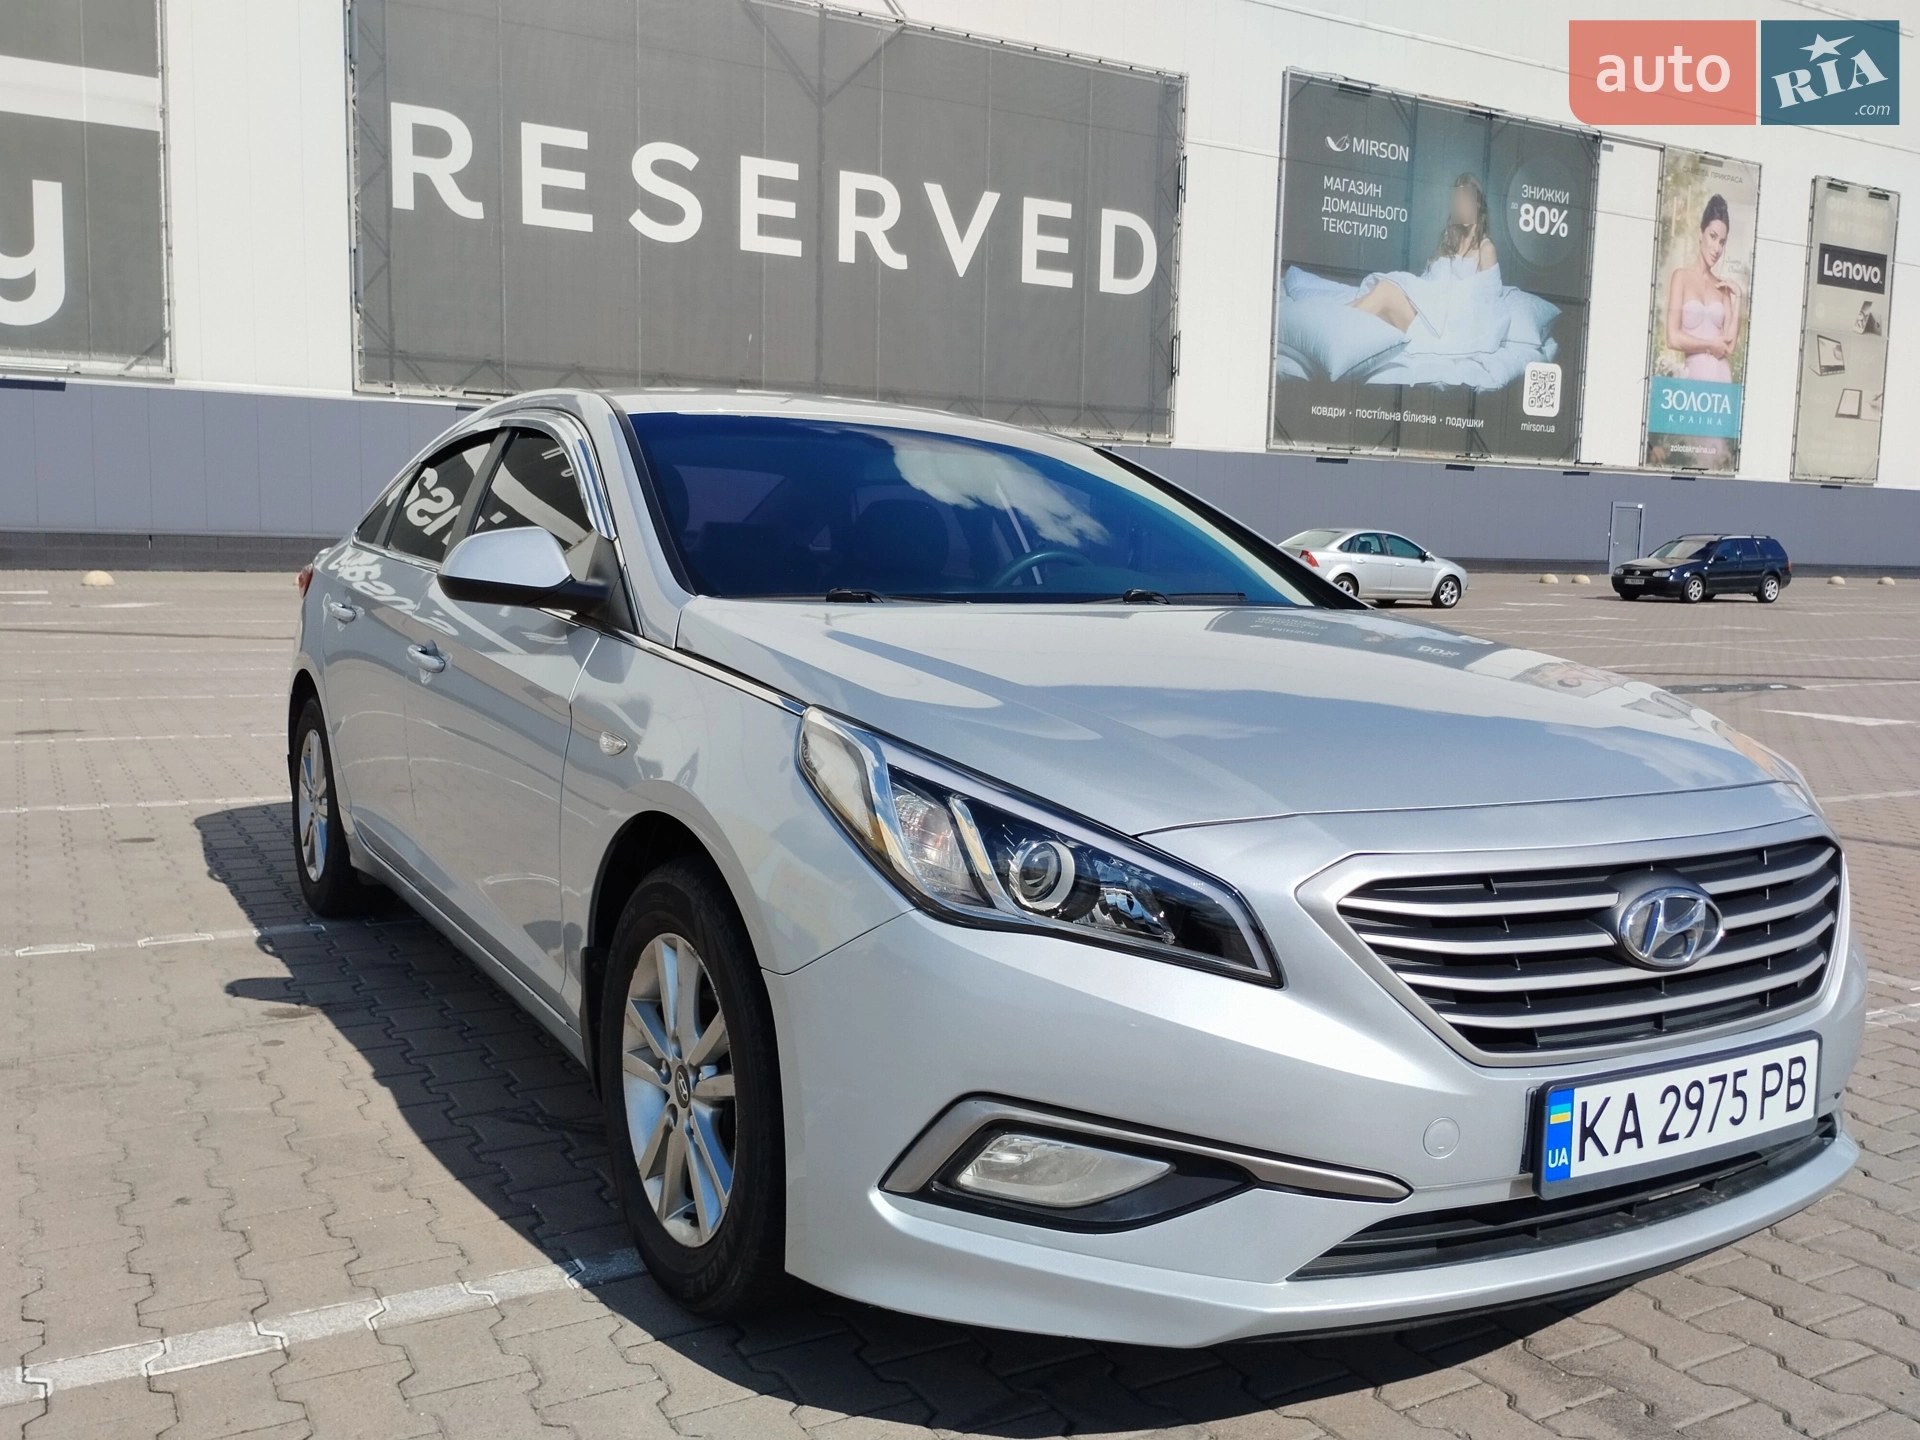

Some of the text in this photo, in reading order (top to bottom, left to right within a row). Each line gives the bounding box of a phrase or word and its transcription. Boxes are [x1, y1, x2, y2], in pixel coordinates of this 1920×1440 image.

[1352, 136, 1409, 162] MIRSON
[390, 102, 1157, 295] RESERVED
[1323, 175, 1382, 198] МАГАЗИН
[1521, 183, 1570, 205] ЗНИЖКИ
[1322, 196, 1408, 223] ДОМАШНЬОГО
[1518, 203, 1569, 238] 80%
[1321, 217, 1388, 240] ТЕКСТИЛЮ
[1823, 253, 1881, 284] Lenovo
[1660, 388, 1732, 415] ЗОЛОТА
[1311, 405, 1484, 429] ковдри постільна білизна подушки
[1520, 421, 1556, 433] mirson.ua
[1578, 1055, 1808, 1162] KA 2975 PB
[1547, 1148, 1569, 1169] UA
